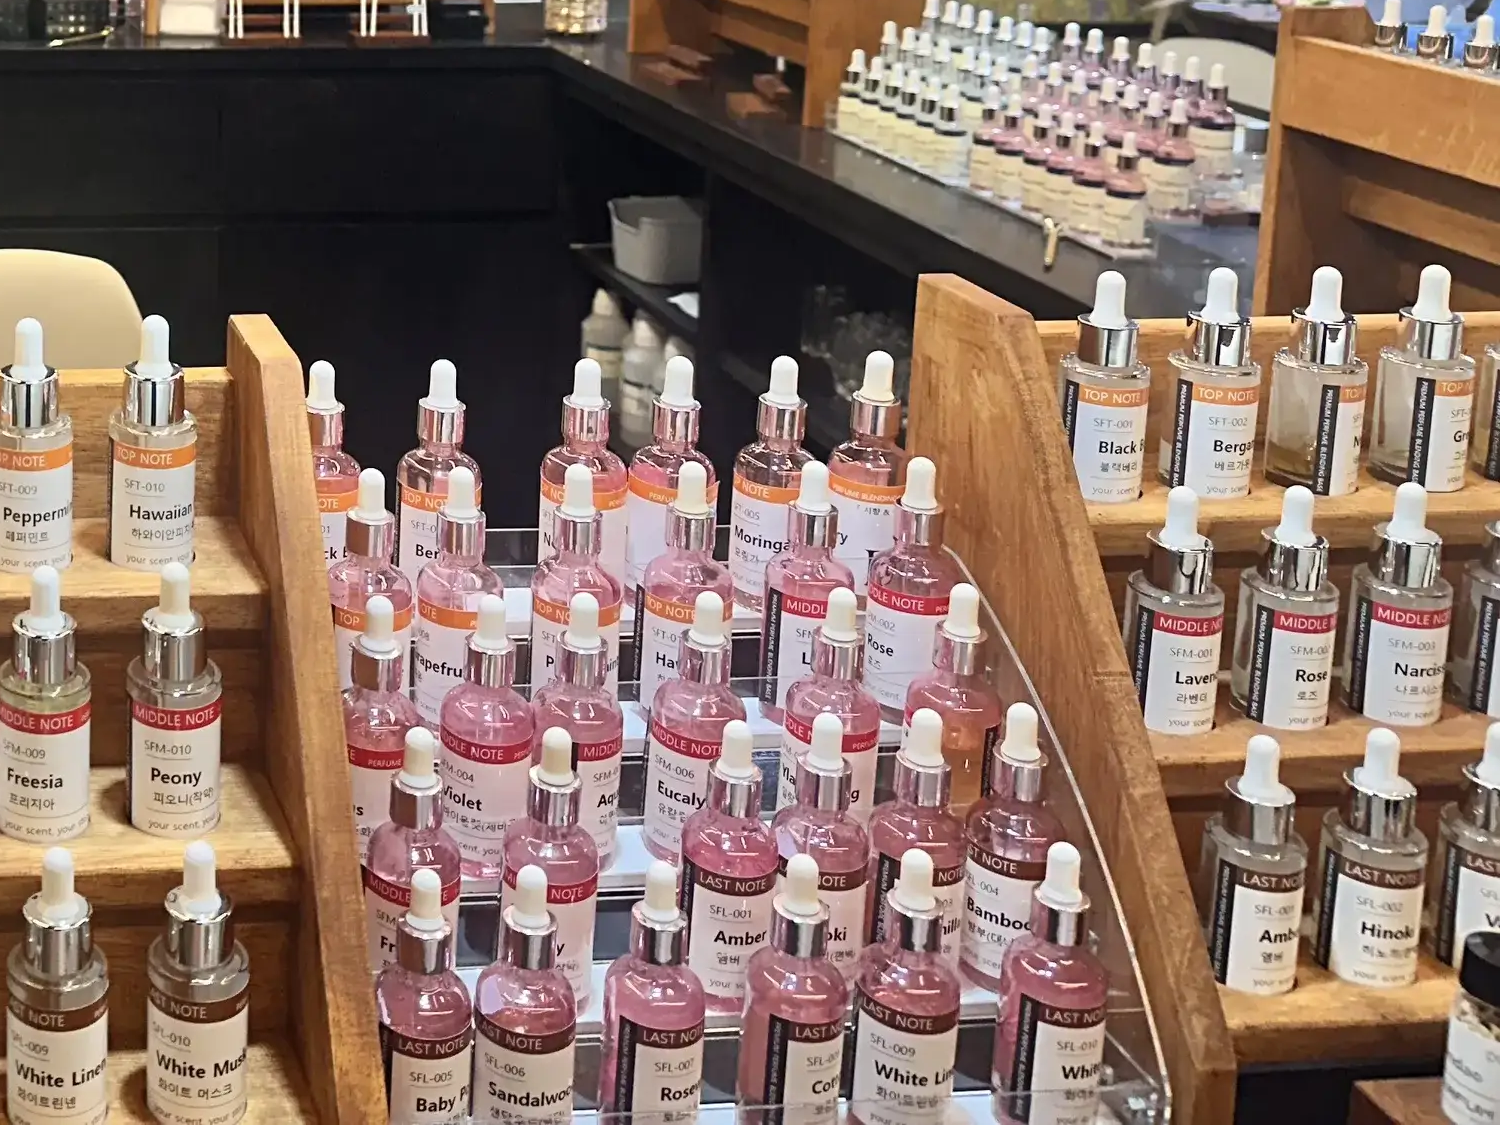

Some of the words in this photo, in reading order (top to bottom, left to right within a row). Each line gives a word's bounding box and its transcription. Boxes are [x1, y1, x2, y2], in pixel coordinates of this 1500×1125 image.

[1084, 388, 1109, 403] TOP
[1112, 391, 1141, 405] NOTE
[1198, 386, 1223, 401] TOP
[1227, 390, 1255, 404] NOTE
[1441, 381, 1467, 394] TOP
[1093, 417, 1134, 431] SFT-001
[1208, 415, 1248, 428] SFT-002
[117, 445, 136, 462] TOP
[140, 451, 174, 466] NOTE
[1098, 440, 1138, 456] Black
[1413, 438, 1425, 469] BLENDING
[12, 454, 46, 468] NOTE
[1318, 446, 1330, 478] BLENDING
[124, 477, 165, 493] SFT-010
[741, 480, 770, 499] NOTE
[1091, 485, 1114, 497] your
[403, 489, 422, 506] TOP
[129, 504, 193, 522] Hawaiian
[734, 524, 791, 556] Moringa
[534, 599, 552, 616] TOP
[645, 596, 663, 613] TOP
[891, 596, 925, 613] NOTE
[339, 611, 360, 626] TOP
[1159, 616, 1209, 634] MIDDLE
[1279, 614, 1329, 632] MIDDLE
[1376, 606, 1431, 626] MIDDLE
[867, 632, 895, 658] Rose
[1169, 646, 1214, 659] SFM-001
[1388, 637, 1436, 653] SFM-003
[1253, 669, 1265, 701] BLENDING
[1295, 668, 1328, 684] Rose
[1176, 691, 1209, 706] 라벤더
[40, 713, 74, 732] NOTE
[134, 703, 180, 728] MIDDLE
[185, 706, 215, 725] NOTE
[1168, 717, 1191, 729] your
[652, 722, 688, 750] MIDDLE
[143, 739, 192, 756] SFM-010
[470, 746, 505, 762] NOTE
[653, 753, 695, 780] SFM-006
[7, 767, 64, 790] Freesia
[150, 767, 202, 788] Peony
[9, 792, 55, 811] 프리지아
[442, 785, 484, 813] Violet
[982, 853, 1018, 875] NOTE
[1345, 861, 1381, 882] LAST
[699, 874, 730, 893] LAST
[735, 878, 767, 894] NOTE
[1243, 872, 1279, 890] LAST
[551, 886, 584, 901] NOTE
[708, 903, 753, 920] SFL-001
[713, 928, 767, 948] Amber
[170, 1001, 208, 1019] NOTE
[862, 995, 892, 1023] LAST
[894, 1012, 934, 1032] NOTE
[1044, 1007, 1079, 1024] LAST
[29, 1011, 65, 1028] NOTE
[643, 1030, 675, 1046] LAST
[795, 1023, 827, 1039] LAST
[398, 1037, 431, 1055] LAST
[435, 1037, 467, 1055] NOTE
[506, 1032, 542, 1051] NOTE
[869, 1033, 917, 1058] SFL-009
[14, 1059, 64, 1088] White
[71, 1055, 107, 1087] Linen
[155, 1049, 206, 1079] White
[484, 1052, 526, 1078] SFL-006
[409, 1069, 453, 1083] SFL-005
[874, 1059, 929, 1088] White
[197, 1082, 232, 1101] 머스크
[416, 1094, 457, 1115] Baby
